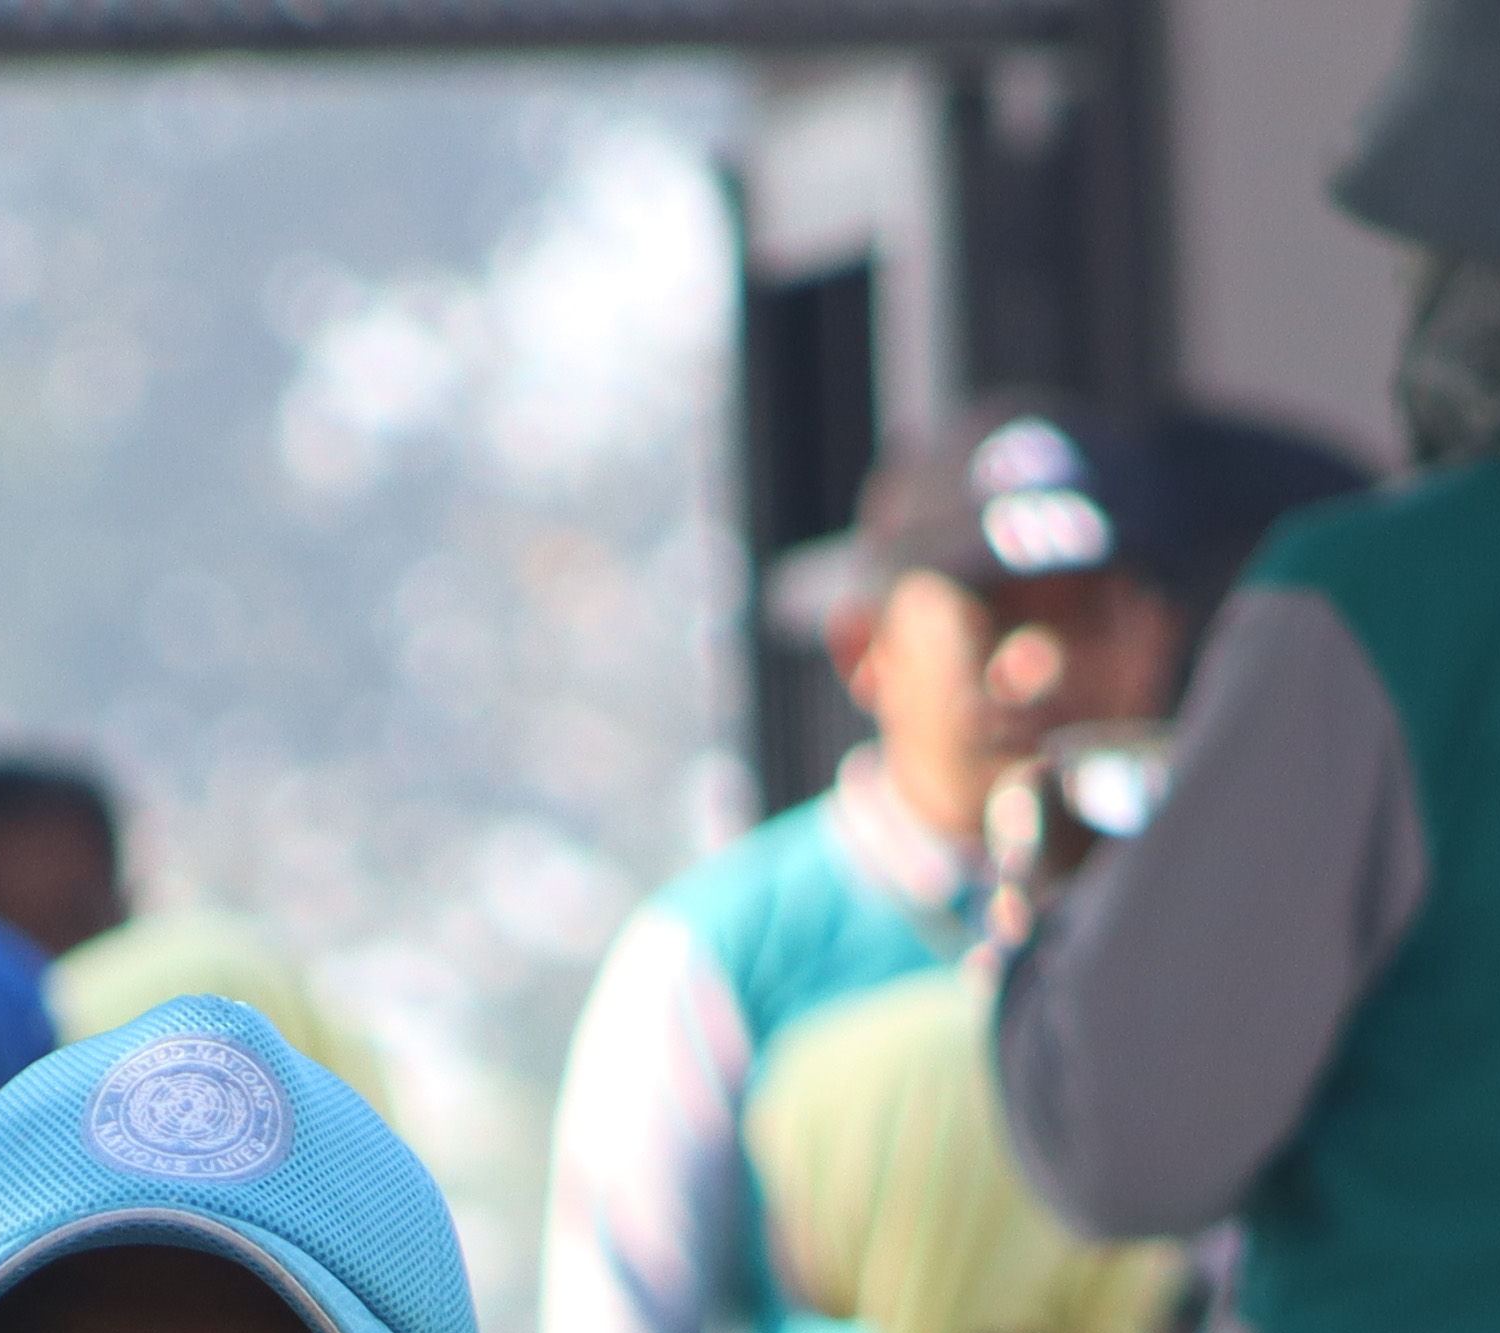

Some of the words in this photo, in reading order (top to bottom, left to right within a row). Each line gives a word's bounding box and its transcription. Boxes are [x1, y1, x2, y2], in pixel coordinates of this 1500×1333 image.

[109, 1046, 185, 1093] UNITED
[196, 1045, 272, 1110] NATIONS
[99, 1120, 187, 1172] NATIONS
[200, 1137, 267, 1172] UNIES
